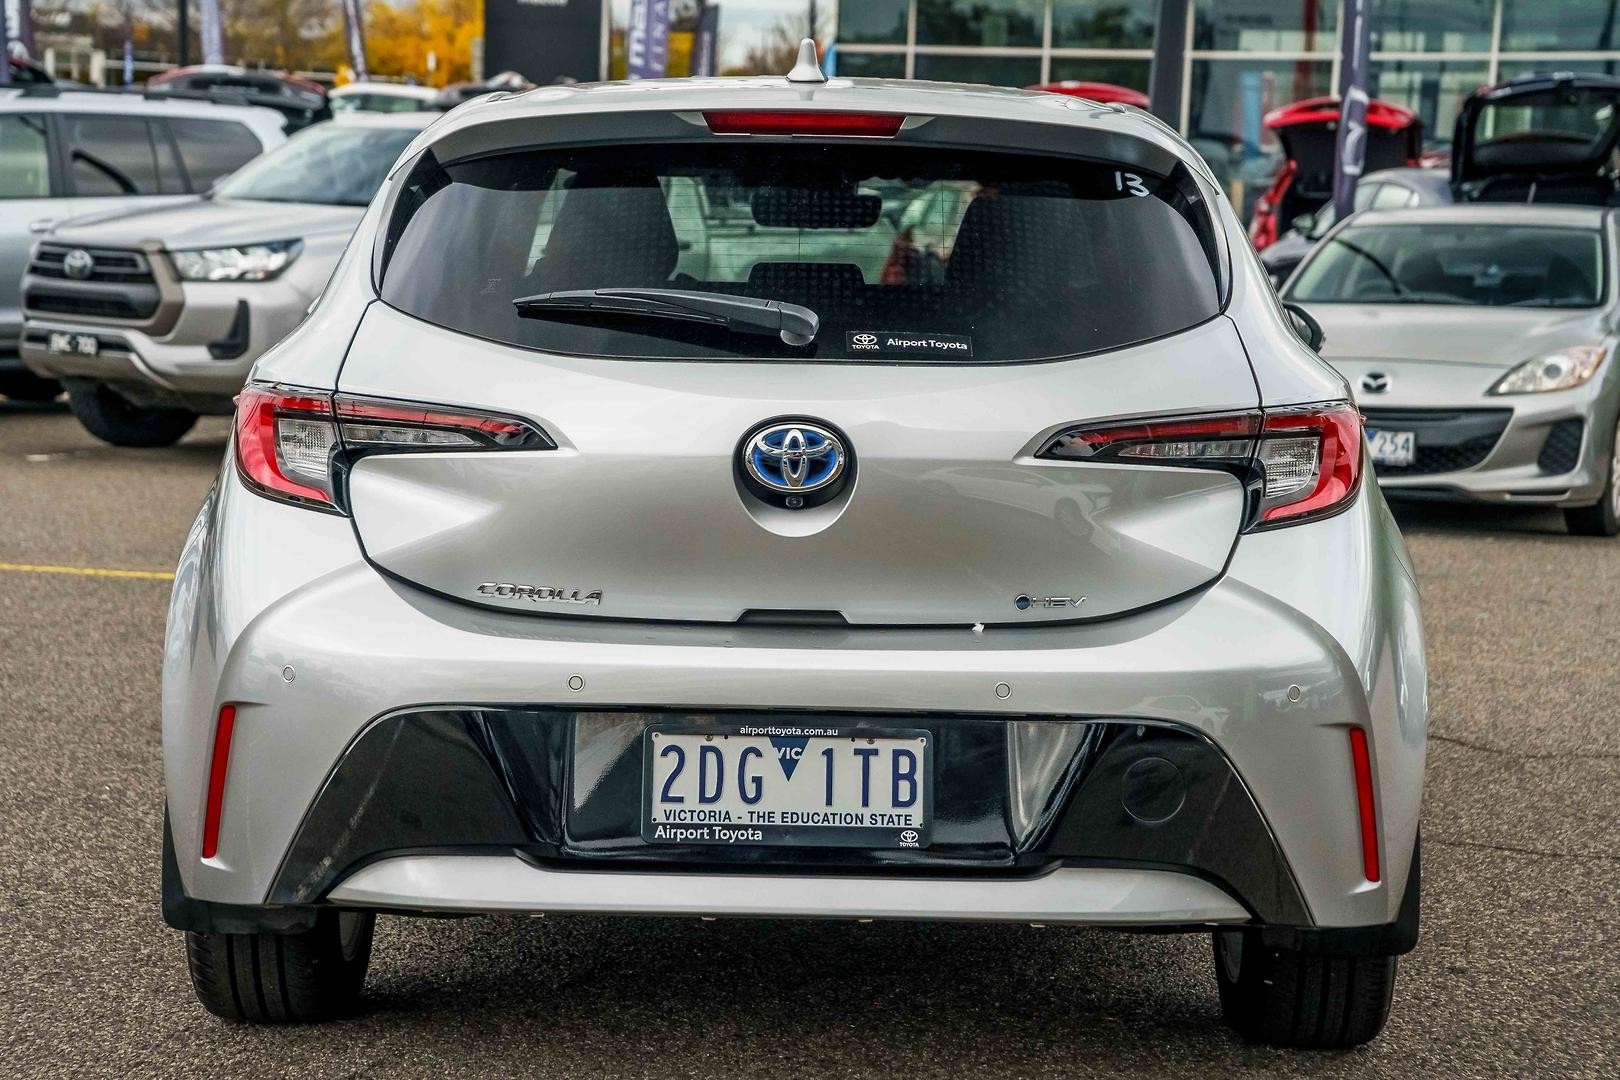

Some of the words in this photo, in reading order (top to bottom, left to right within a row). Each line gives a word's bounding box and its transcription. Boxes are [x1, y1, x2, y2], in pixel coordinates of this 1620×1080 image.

[1115, 170, 1150, 198] 13
[887, 338, 928, 348] Airport
[928, 340, 968, 350] Toyota
[477, 581, 603, 606] COROLLA
[1031, 596, 1087, 609] HEV
[739, 725, 839, 737] airporttoyota.com.au
[773, 746, 803, 760] VIC
[663, 809, 732, 823] VICTORIA
[747, 811, 776, 824] THE
[780, 811, 865, 826] EDUCATION
[869, 813, 913, 827] STATE
[654, 825, 710, 841] Airport
[712, 827, 763, 842] Toyota
